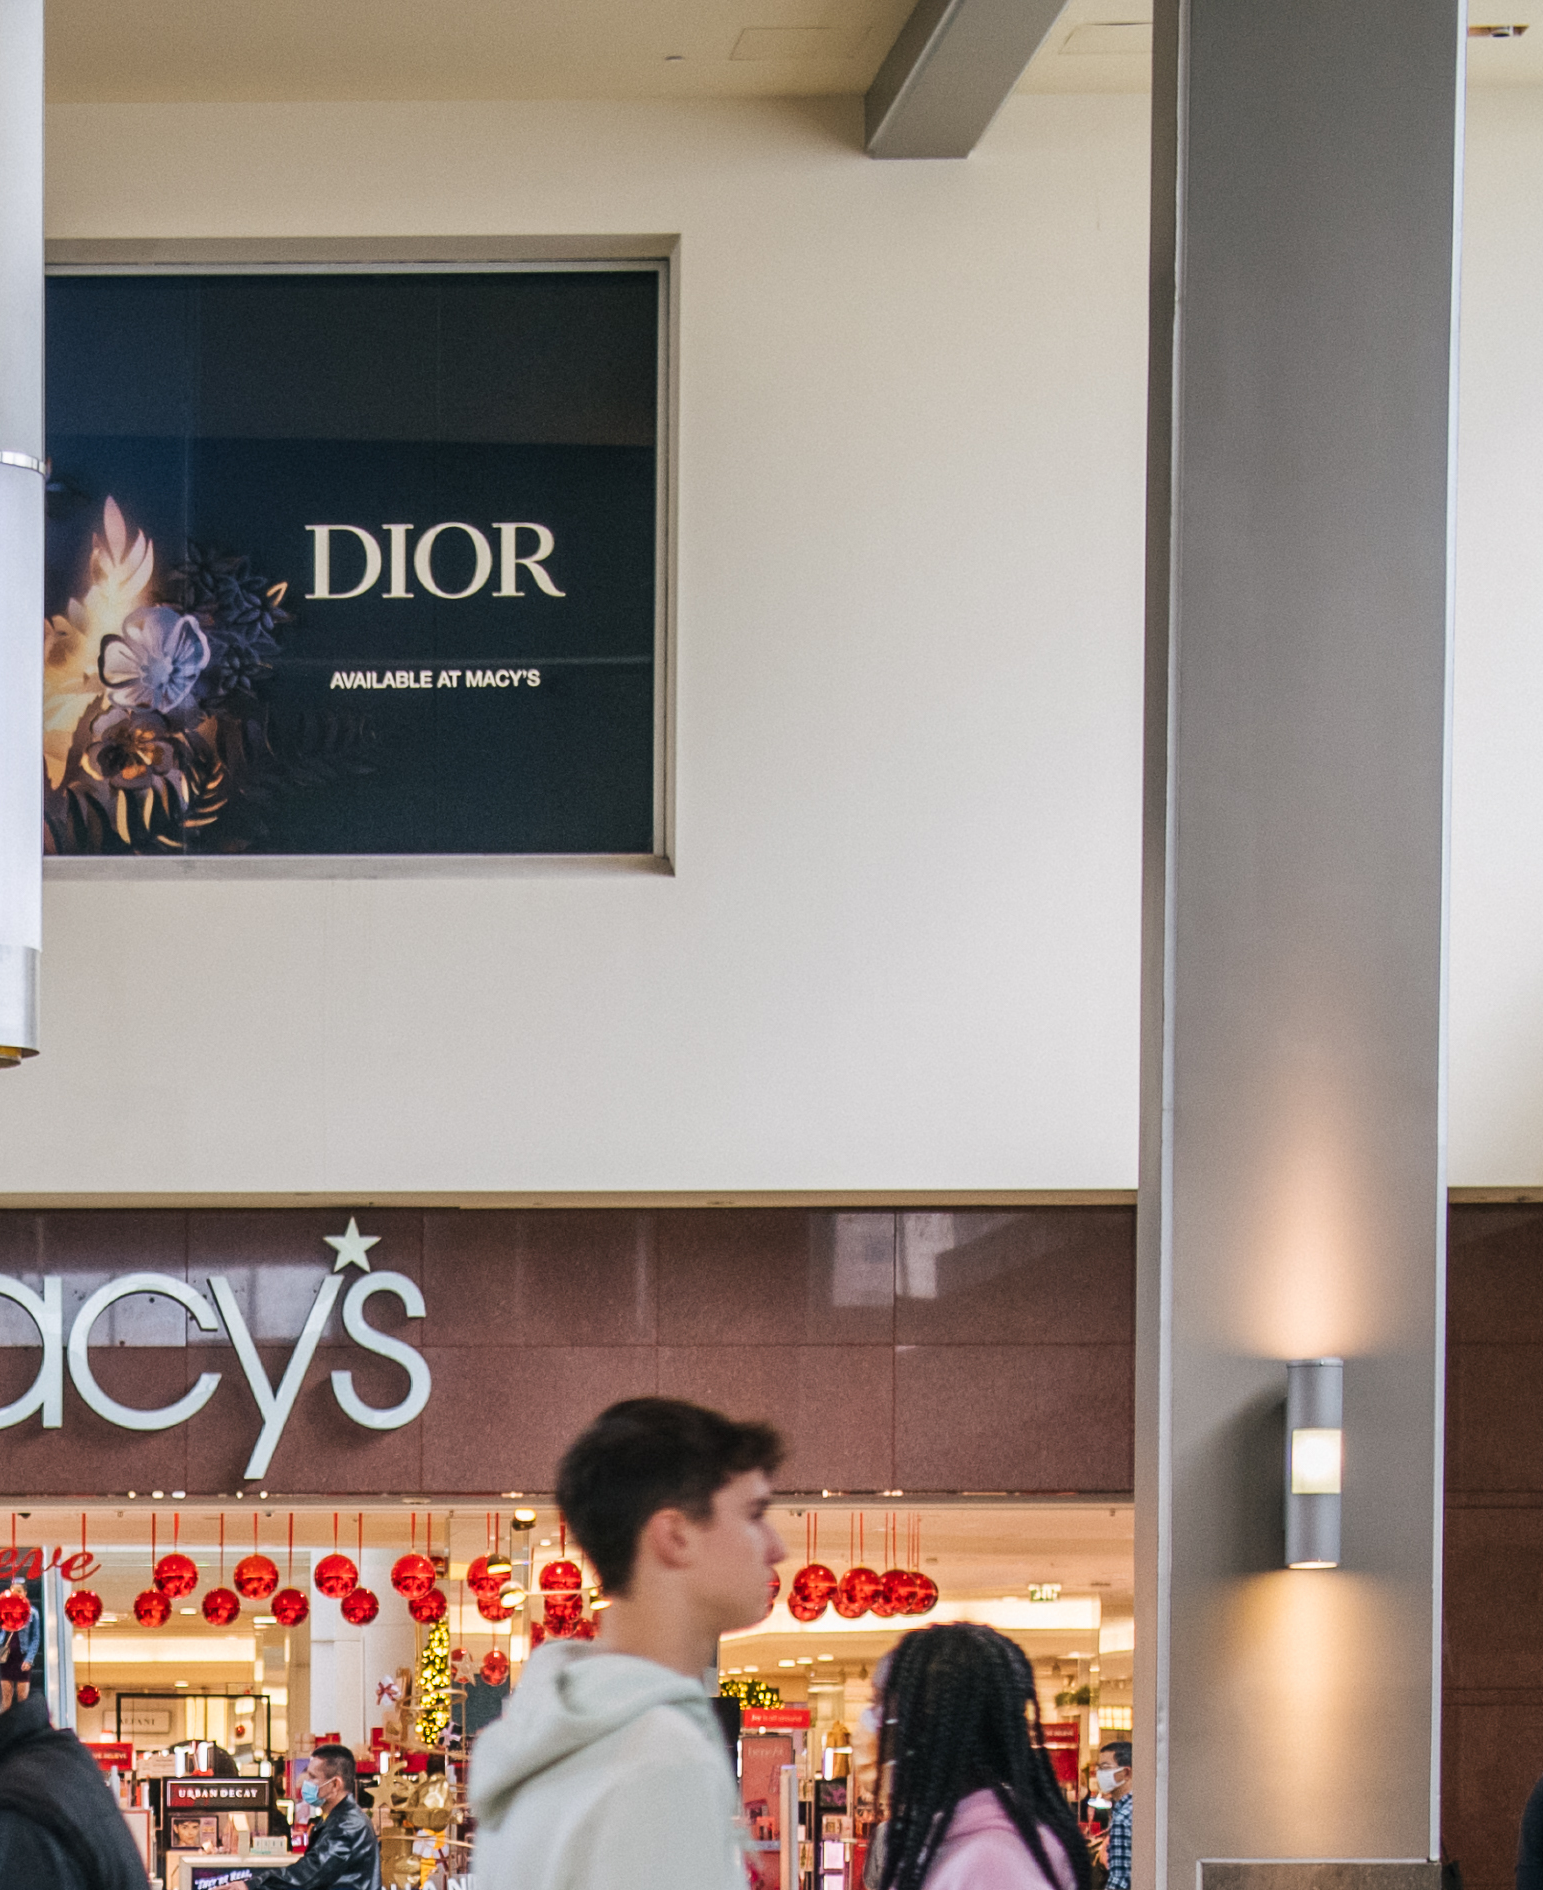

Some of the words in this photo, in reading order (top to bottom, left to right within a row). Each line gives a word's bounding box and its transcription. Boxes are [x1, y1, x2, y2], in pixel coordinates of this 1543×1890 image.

[303, 521, 567, 600] DIOR
[330, 670, 433, 690] AVAILABLE
[436, 670, 461, 689] AT
[464, 668, 541, 689] MACY'S
[178, 1789, 218, 1799] URBAN
[219, 1789, 259, 1799] DECAY
